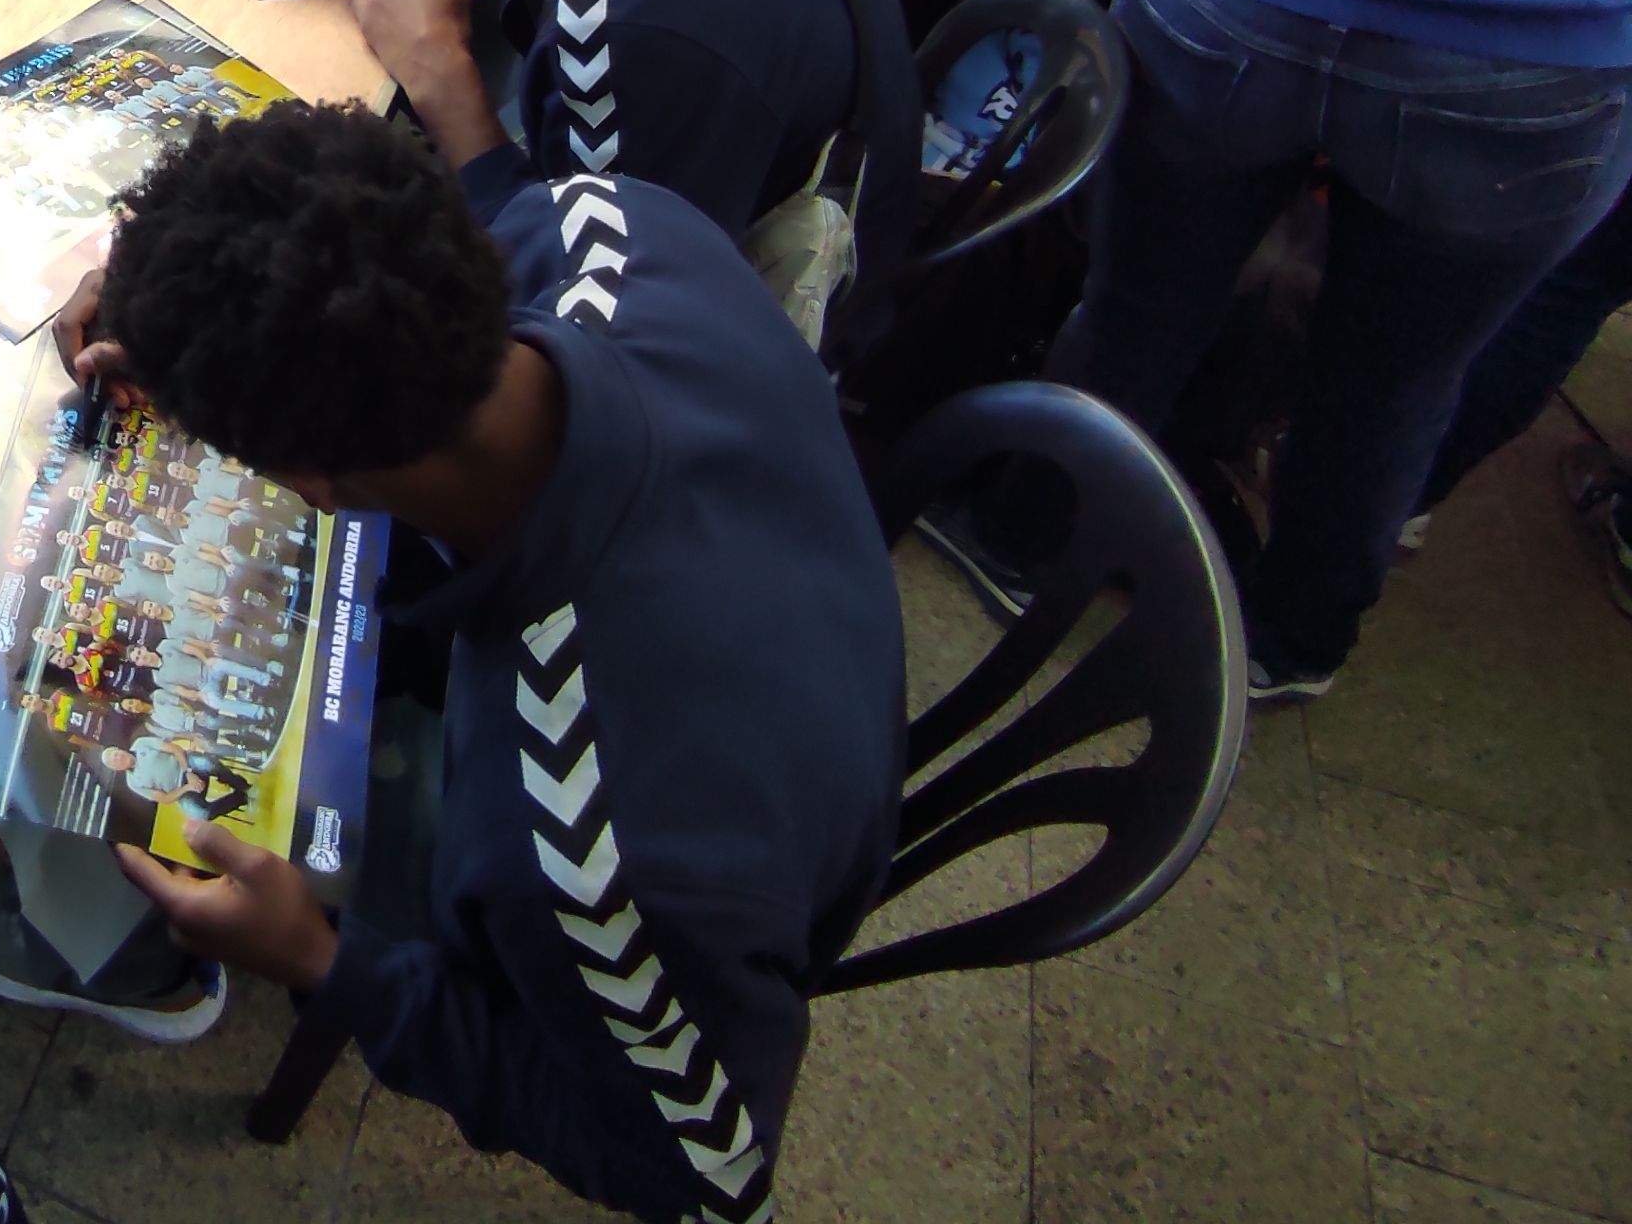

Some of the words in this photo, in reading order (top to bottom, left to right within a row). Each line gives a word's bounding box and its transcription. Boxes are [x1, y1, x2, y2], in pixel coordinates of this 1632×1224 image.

[338, 521, 362, 600] ANDORRA
[326, 599, 352, 696] MORABANC
[351, 604, 367, 643] 2022/23
[323, 698, 340, 723] BC
